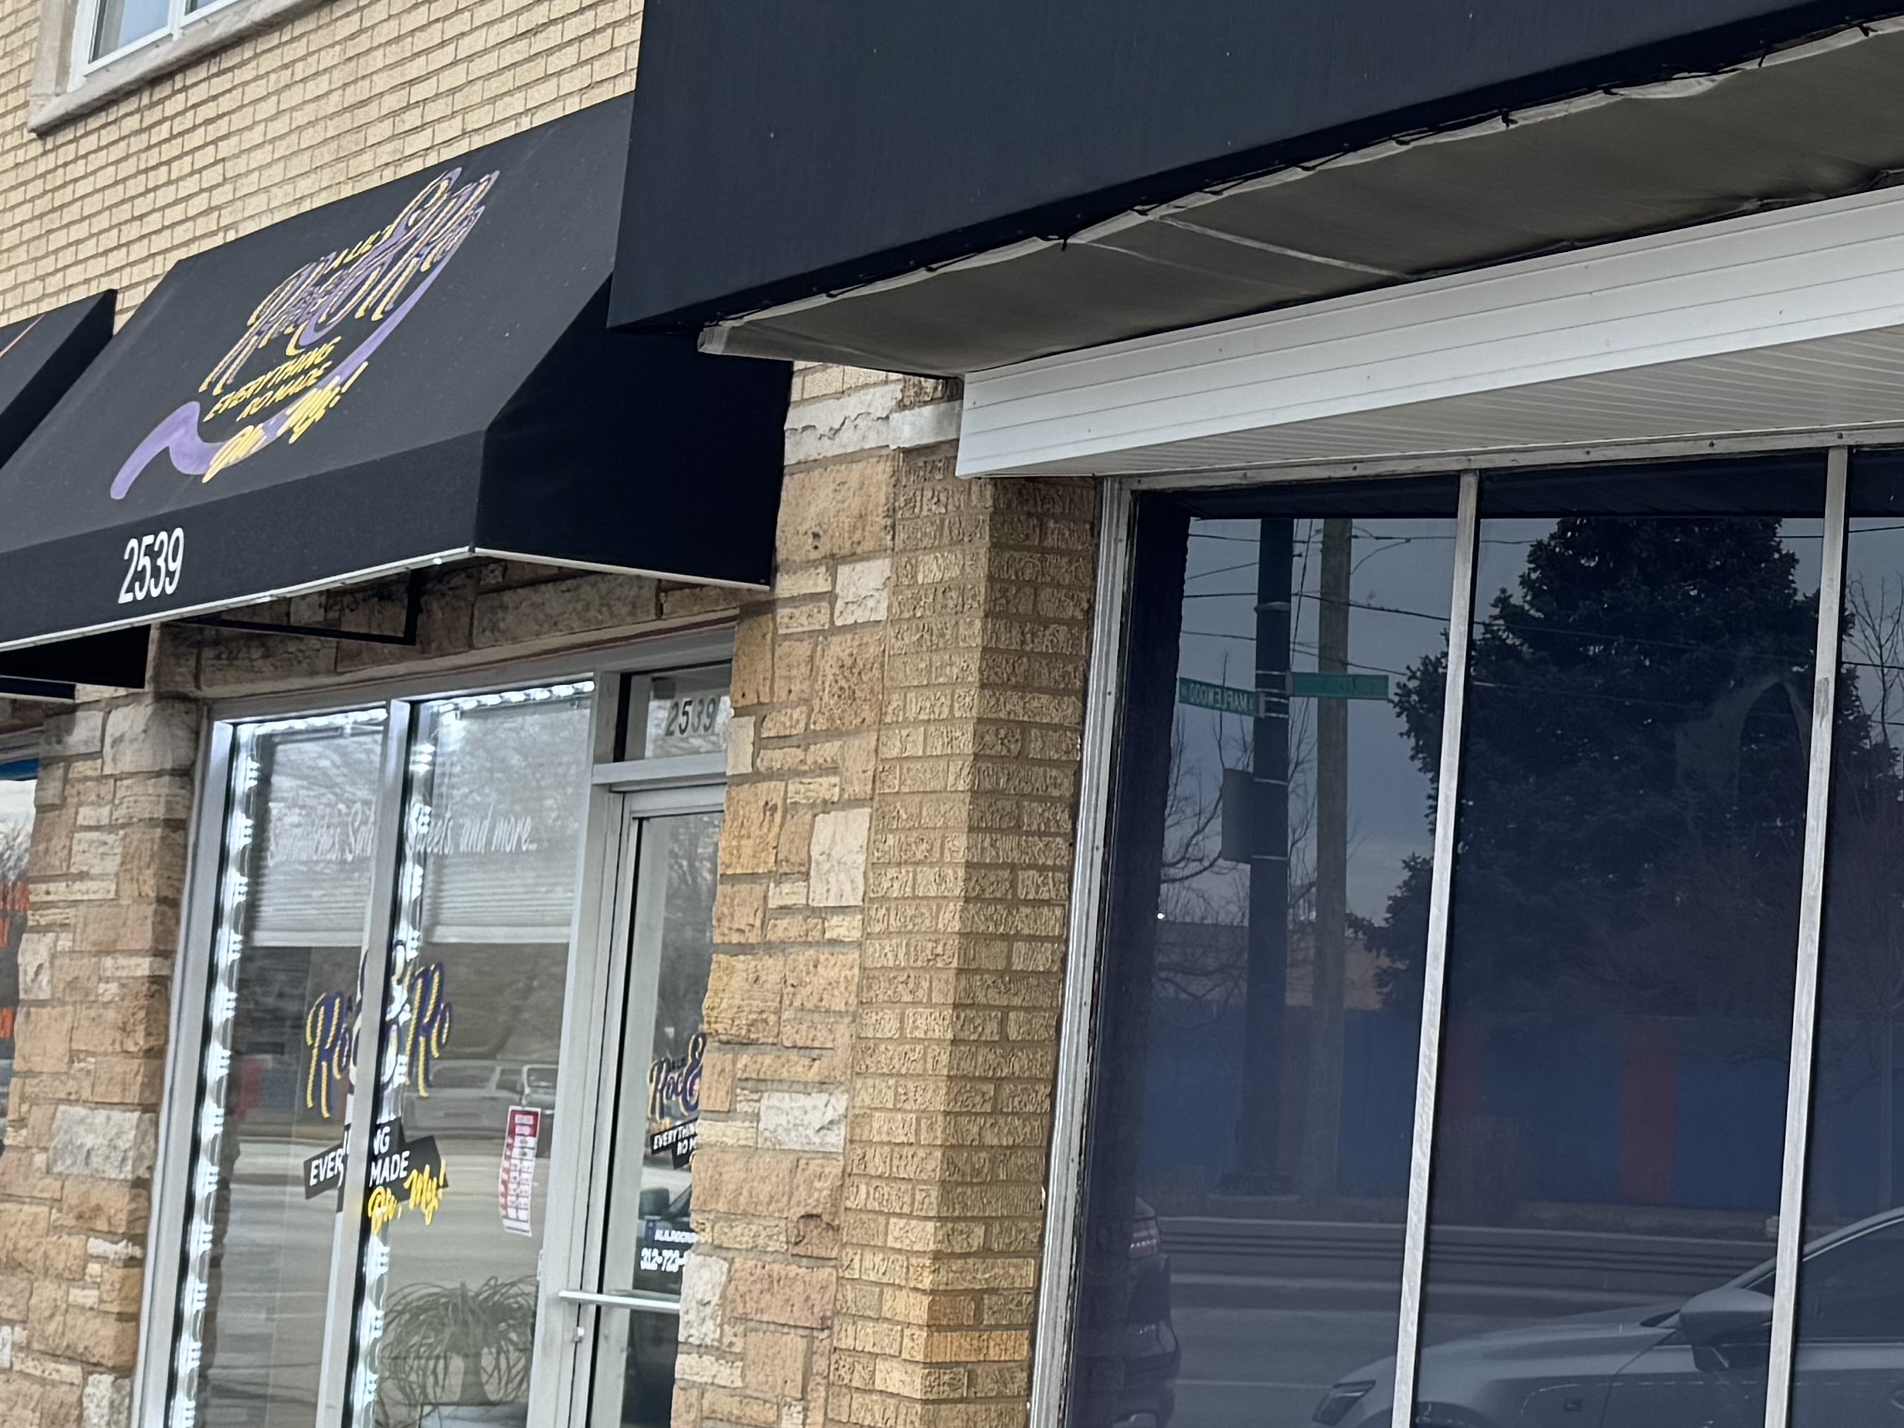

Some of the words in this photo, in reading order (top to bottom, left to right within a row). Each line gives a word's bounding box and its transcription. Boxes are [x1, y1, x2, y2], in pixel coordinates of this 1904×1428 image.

[203, 336, 342, 422] EVERYTHING
[118, 527, 184, 604] 2539
[665, 697, 717, 737] 2539
[460, 803, 494, 854] and
[653, 1123, 696, 1150] EVERYTHIN
[369, 1150, 410, 1187] MADE
